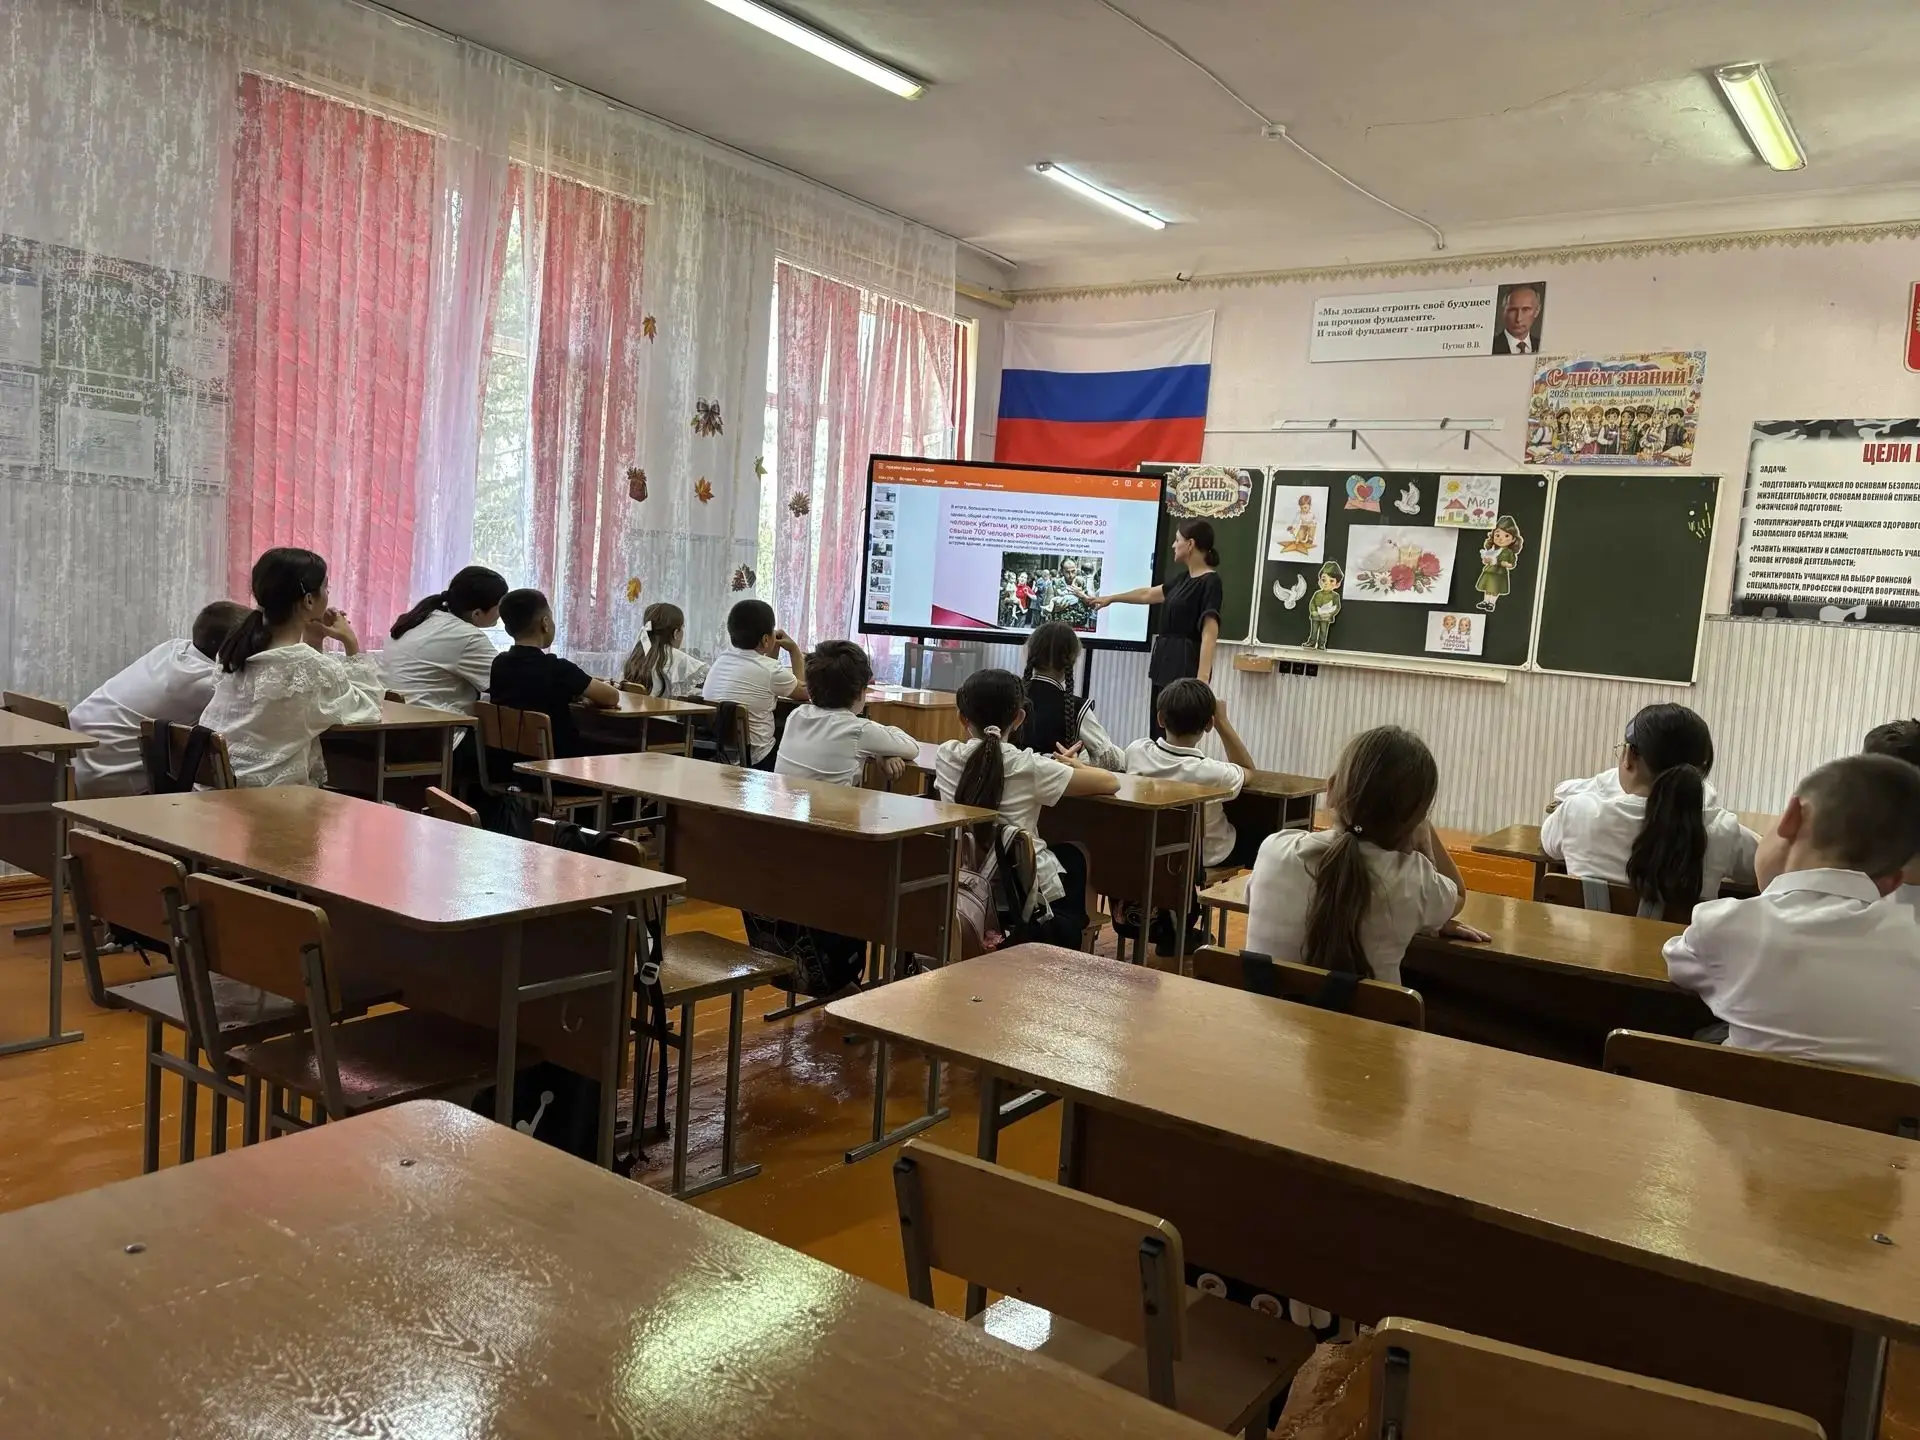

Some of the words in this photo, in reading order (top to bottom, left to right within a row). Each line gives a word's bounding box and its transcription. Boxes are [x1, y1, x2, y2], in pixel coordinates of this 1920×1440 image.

[100, 288, 166, 309] КЛАСС
[1318, 307, 1339, 316] «Мы
[1341, 307, 1380, 316] должны
[1382, 303, 1420, 314] строить
[1423, 301, 1445, 310] своё
[1447, 299, 1491, 310] будущее
[1331, 318, 1371, 328] прочном
[1327, 327, 1353, 337] такой
[1355, 326, 1408, 337] фундамент
[1416, 323, 1484, 333] патриотизм».
[1442, 342, 1465, 351] Путин
[1467, 341, 1481, 349] В.В.
[1546, 368, 1563, 388] С
[1566, 368, 1614, 388] днём
[1614, 366, 1695, 386] знаний!
[1549, 389, 1569, 398] 2026
[1571, 390, 1583, 398] год
[1585, 389, 1620, 398] единства
[1621, 388, 1653, 398] народов
[1654, 387, 1686, 396] России!
[1862, 443, 1912, 465] ЦЕЛИ
[1760, 465, 1788, 474] ЗАДАЧИ:
[1189, 477, 1227, 490] ДЕНЬ
[1808, 481, 1844, 490] УЧАЩИХСЯ
[1855, 482, 1887, 490] ОСНОВАМ
[1182, 489, 1233, 504] ЗНАНИЙ!
[1829, 493, 1862, 501] ОСНОВАМ
[1863, 492, 1892, 501] ВОЕННОЙ
[1755, 502, 1798, 511] ФИЗИЧЕСКОЙ
[1799, 503, 1843, 512] ПОДГОТОВКЕ;
[979, 520, 1008, 529] убитыми,
[1019, 524, 1047, 532] которых
[1823, 520, 1845, 528] СРЕДИ
[1845, 520, 1882, 529] УЧАЩИХСЯ
[1752, 530, 1797, 538] БЕЗОПАСНОГО
[1797, 530, 1822, 538] ОБРАЗА
[1823, 531, 1848, 539] ЖИЗНИ;
[1752, 544, 1781, 553] РАЗВИТЬ
[1782, 546, 1823, 554] ИНИЦИАТИВУ
[1830, 547, 1903, 556] САМОСТОЯТЕЛЬНОСТЬ
[1749, 556, 1774, 564] ОСНОВЕ
[1774, 556, 1803, 564] ИГРОВОЙ
[1804, 557, 1856, 567] ДЕЯТЕЛЬНОСТИ;
[1804, 572, 1840, 581] УЧАЩИХСЯ
[1850, 575, 1875, 583] ВЫБОР
[1876, 575, 1912, 584] ВОИНСКОЙ
[1746, 581, 1801, 591] СПЕЦИАЛЬНОСТИ,
[1801, 583, 1841, 592] ПРОФЕССИИ
[1842, 585, 1874, 594] ОФИЦЕРА
[1745, 593, 1768, 601] ДРУГИХ
[1793, 594, 1827, 603] ВОИНСКИХ
[1828, 596, 1882, 606] ФОРМИРОВАНИЙ
[1889, 600, 1920, 608] ОРГАНОВ
